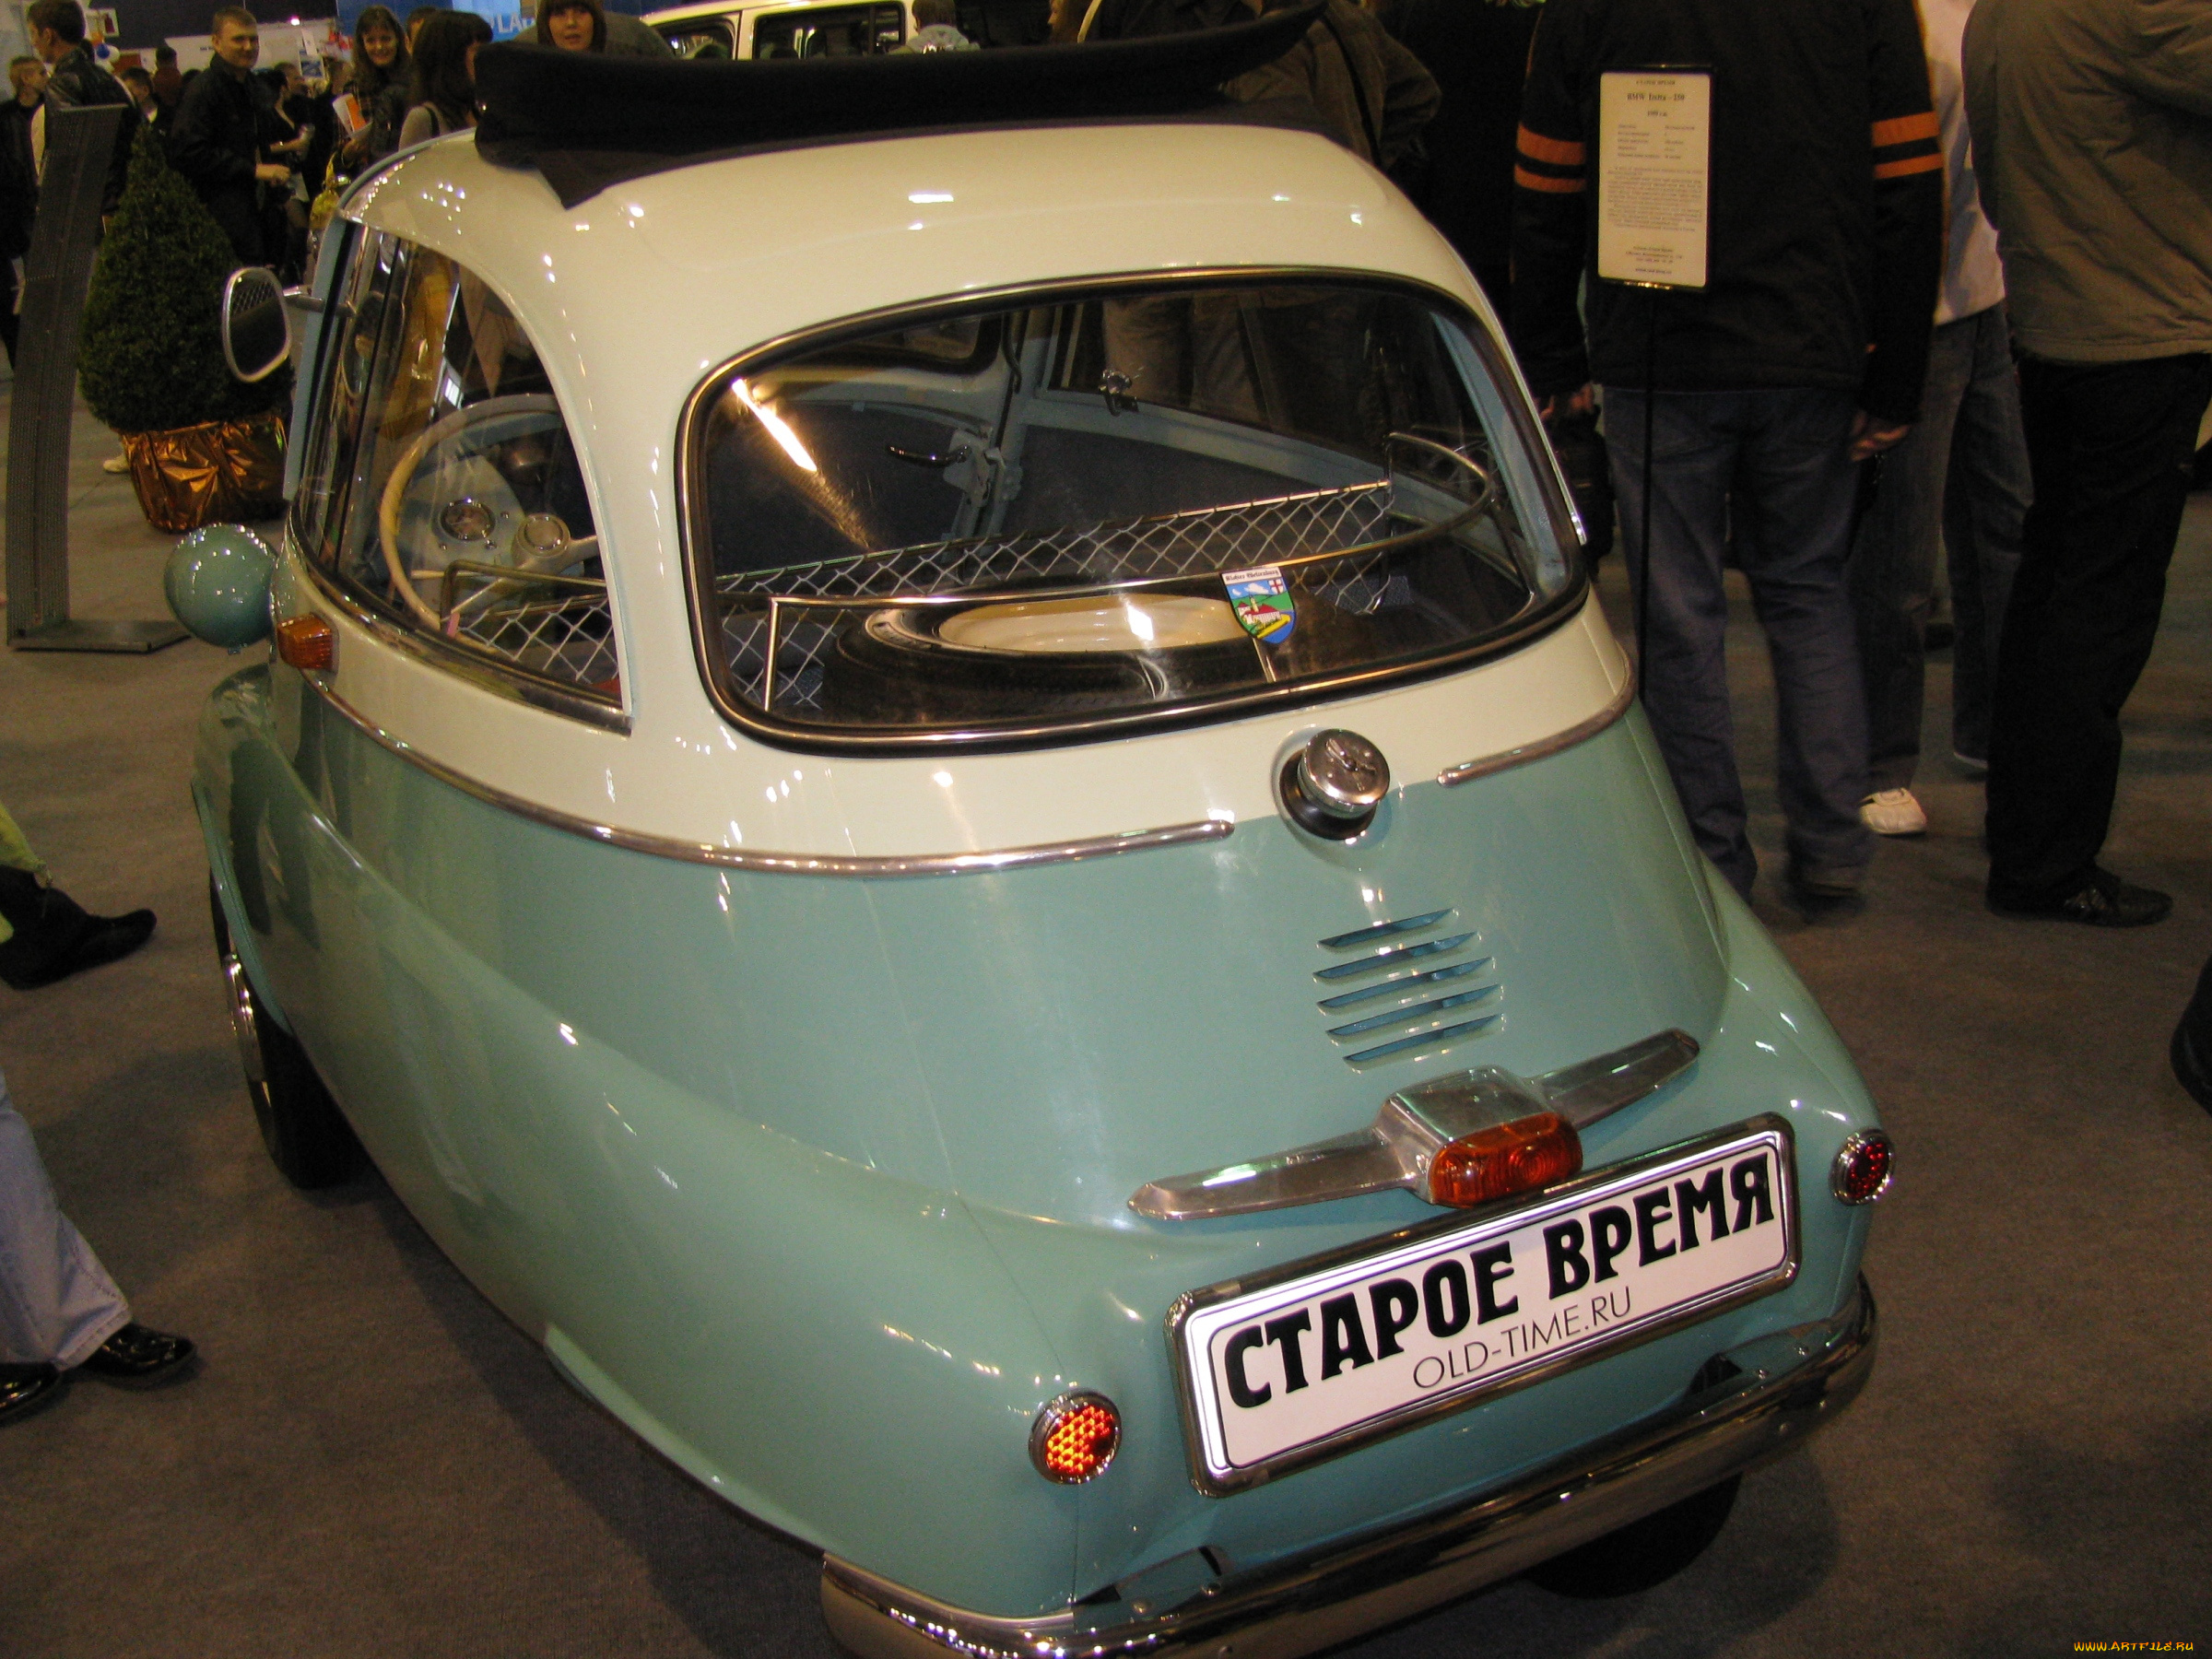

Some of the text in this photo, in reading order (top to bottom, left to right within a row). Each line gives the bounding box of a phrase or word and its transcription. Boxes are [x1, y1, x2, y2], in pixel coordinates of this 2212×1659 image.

[1628, 92, 1644, 100] BMW
[1223, 1152, 1774, 1409] СТАРОЕ ВРЕМЯ
[1413, 1286, 1631, 1389] OLD-TIME.RU
